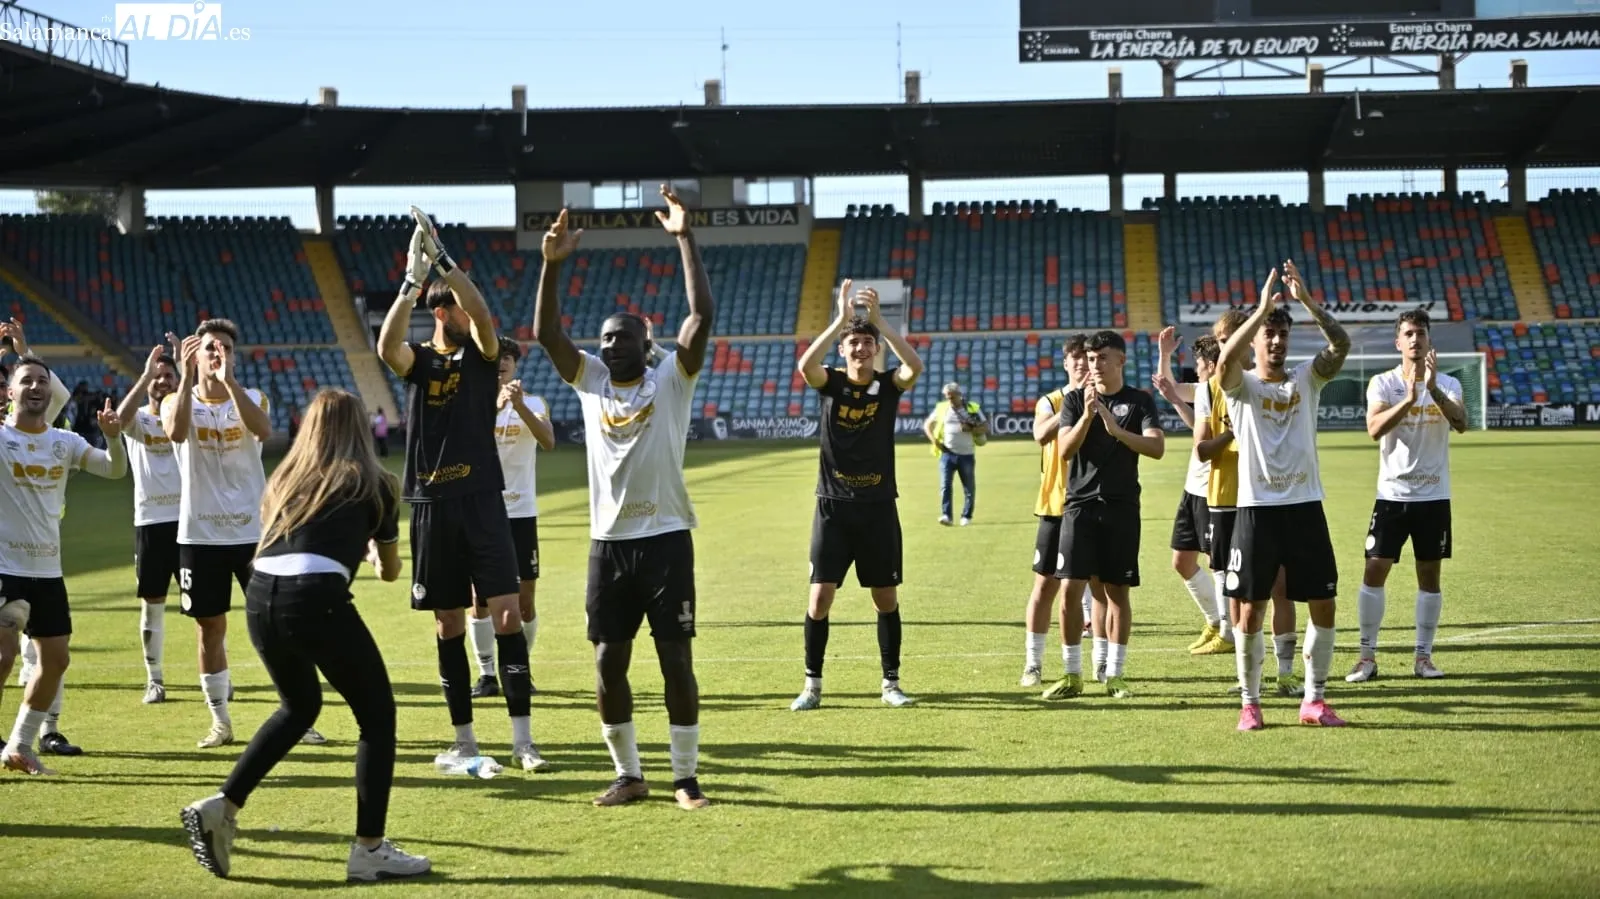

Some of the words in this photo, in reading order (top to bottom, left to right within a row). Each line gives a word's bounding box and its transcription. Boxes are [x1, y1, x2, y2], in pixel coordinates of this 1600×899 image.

[1089, 30, 1133, 43] Energía
[1135, 30, 1173, 40] Charra
[1390, 22, 1433, 35] Energía
[1435, 22, 1473, 33] Charra
[1090, 41, 1116, 59] LA
[1119, 36, 1196, 58] ENERGÍA
[1201, 39, 1225, 56] DE
[1228, 39, 1251, 55] TU
[1254, 36, 1319, 56] EQUIPO
[1391, 29, 1468, 51] ENERGÍA
[1472, 33, 1519, 50] PARA
[1522, 29, 1600, 49] SALAMA
[527, 213, 626, 230] CATILLA
[712, 212, 739, 226] ES
[746, 209, 795, 225] VIDA
[732, 417, 809, 430] SANMAXIMO
[756, 429, 803, 438] TELECOM
[180, 567, 192, 590] 15
